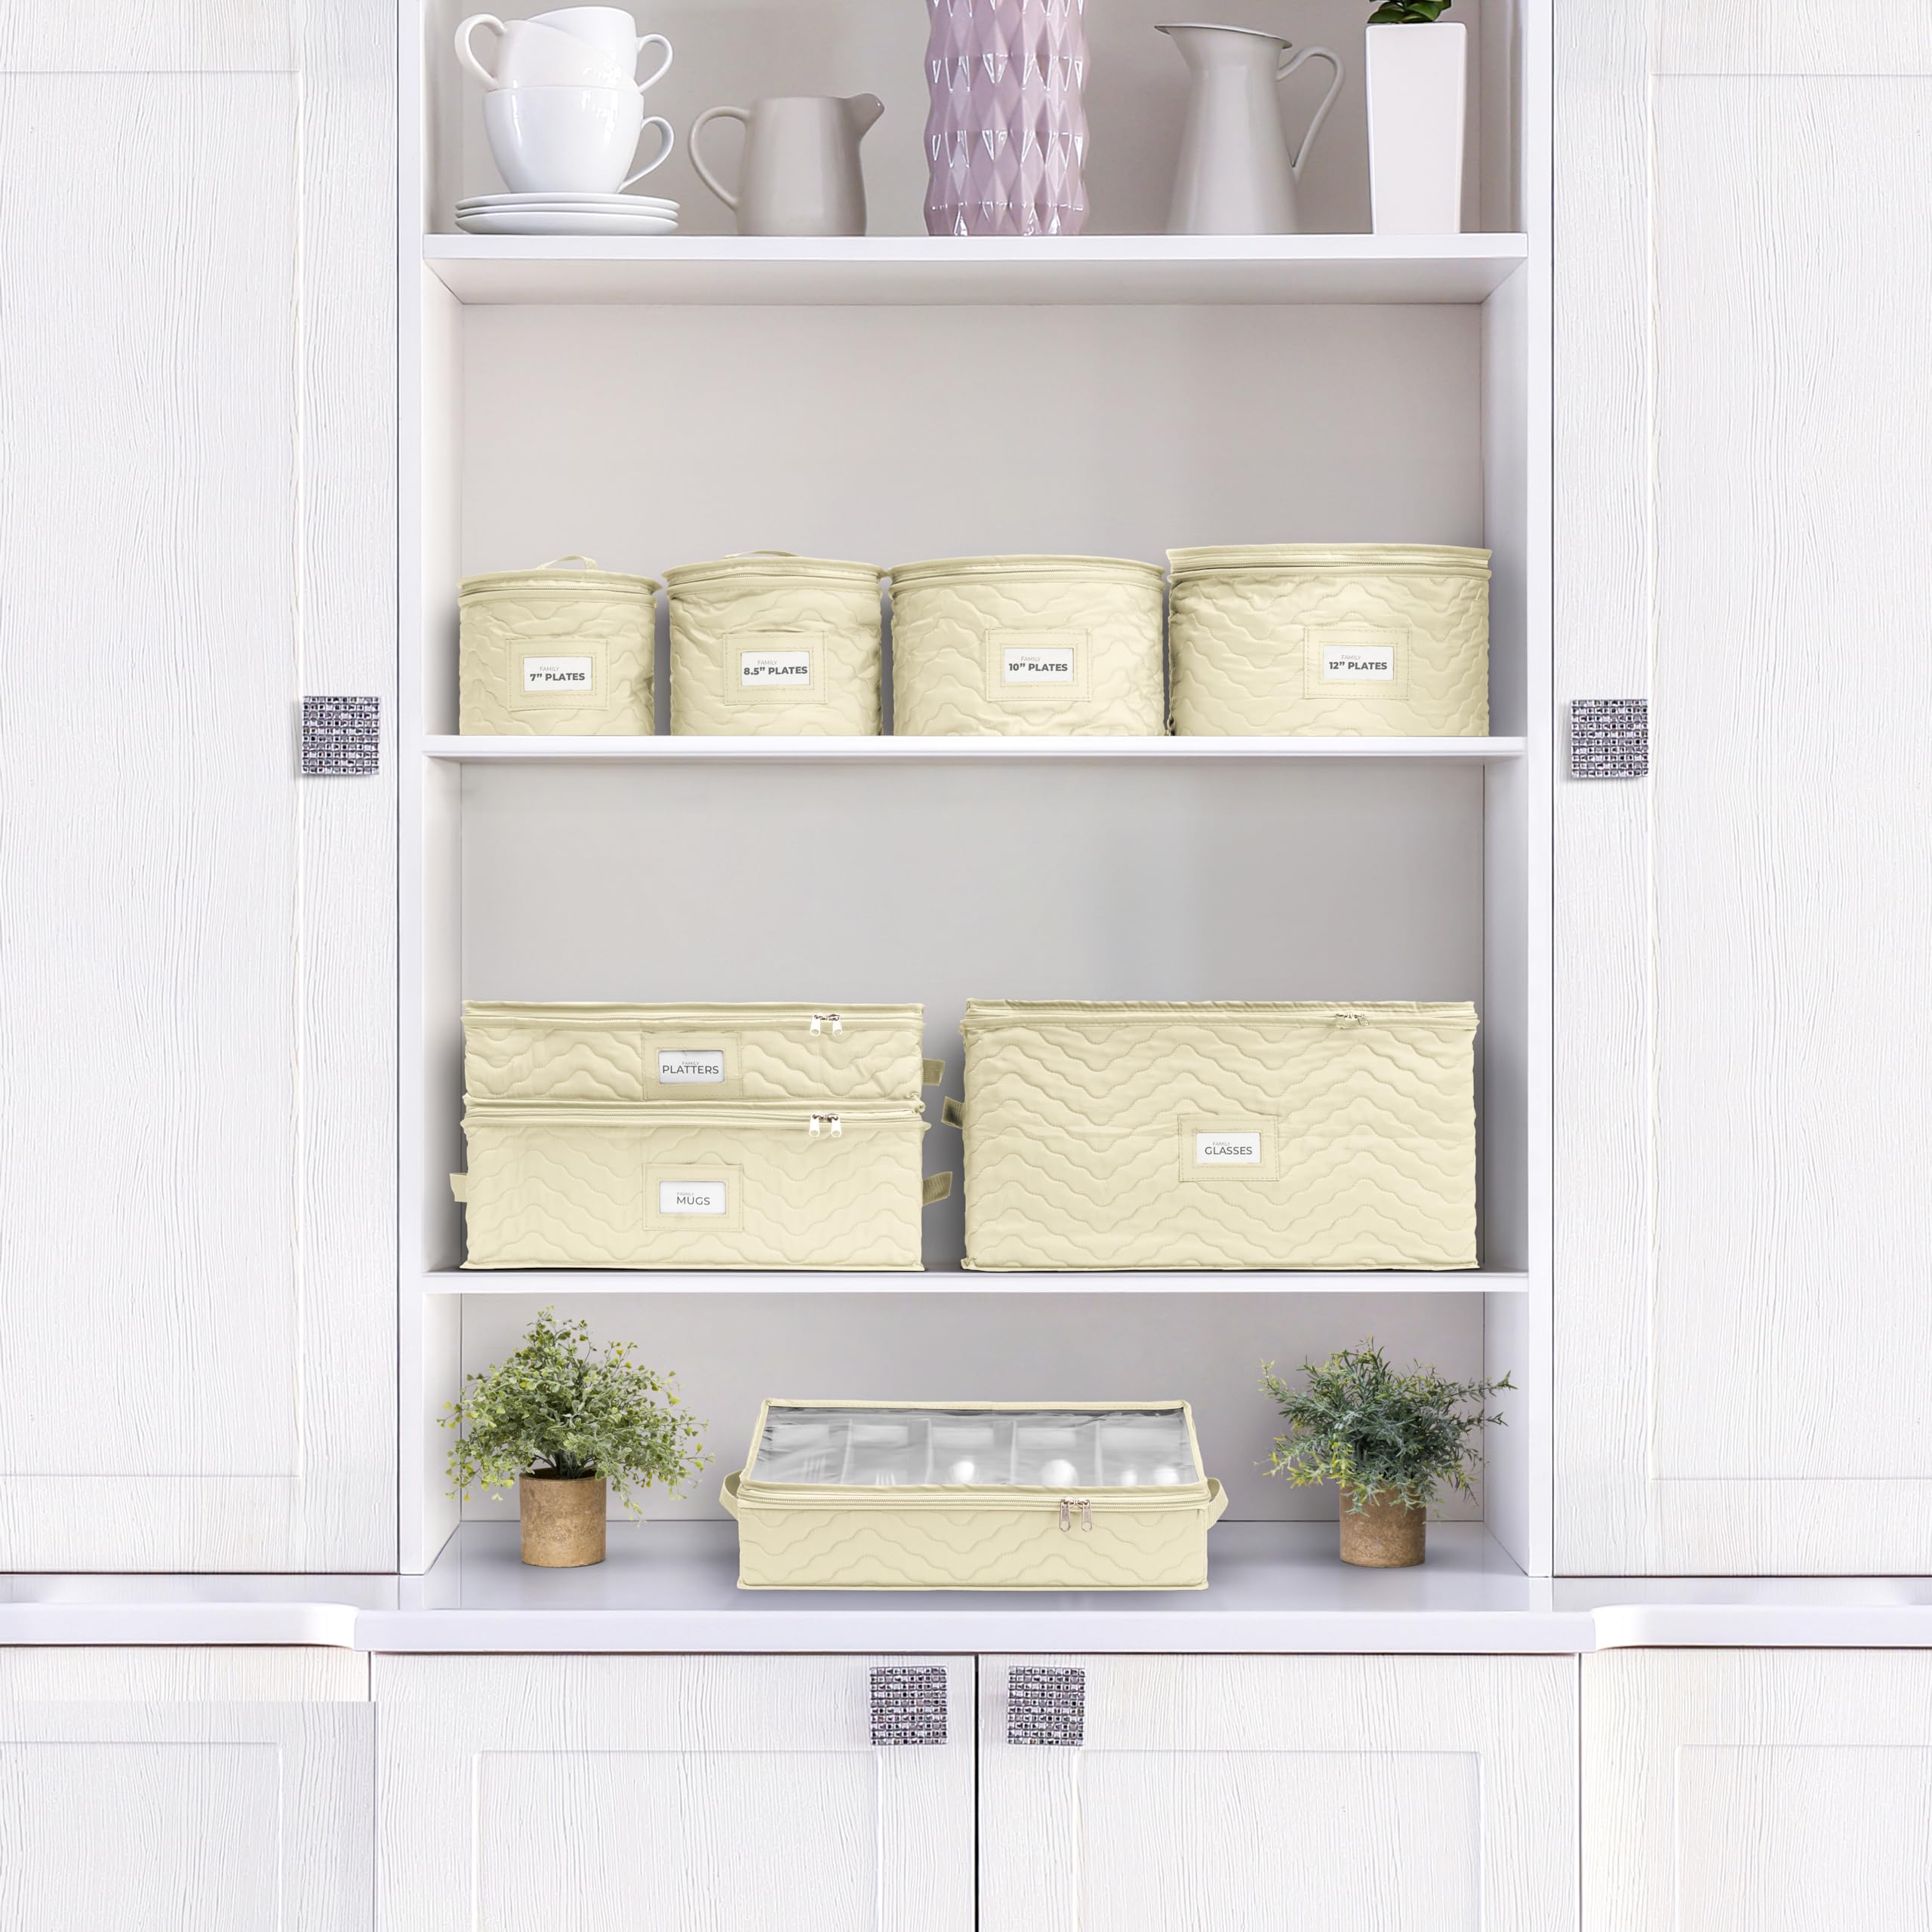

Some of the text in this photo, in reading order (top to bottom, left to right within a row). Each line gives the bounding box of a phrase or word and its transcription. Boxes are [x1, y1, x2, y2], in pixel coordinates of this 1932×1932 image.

[768, 666, 808, 675] PLATES
[1028, 663, 1068, 672] PLATES
[1348, 662, 1388, 670] PLATES
[545, 672, 586, 681] PLATES
[663, 1065, 719, 1074] PLATTERS
[1204, 1146, 1253, 1155] GLASSES
[676, 1196, 710, 1205] MUGS
